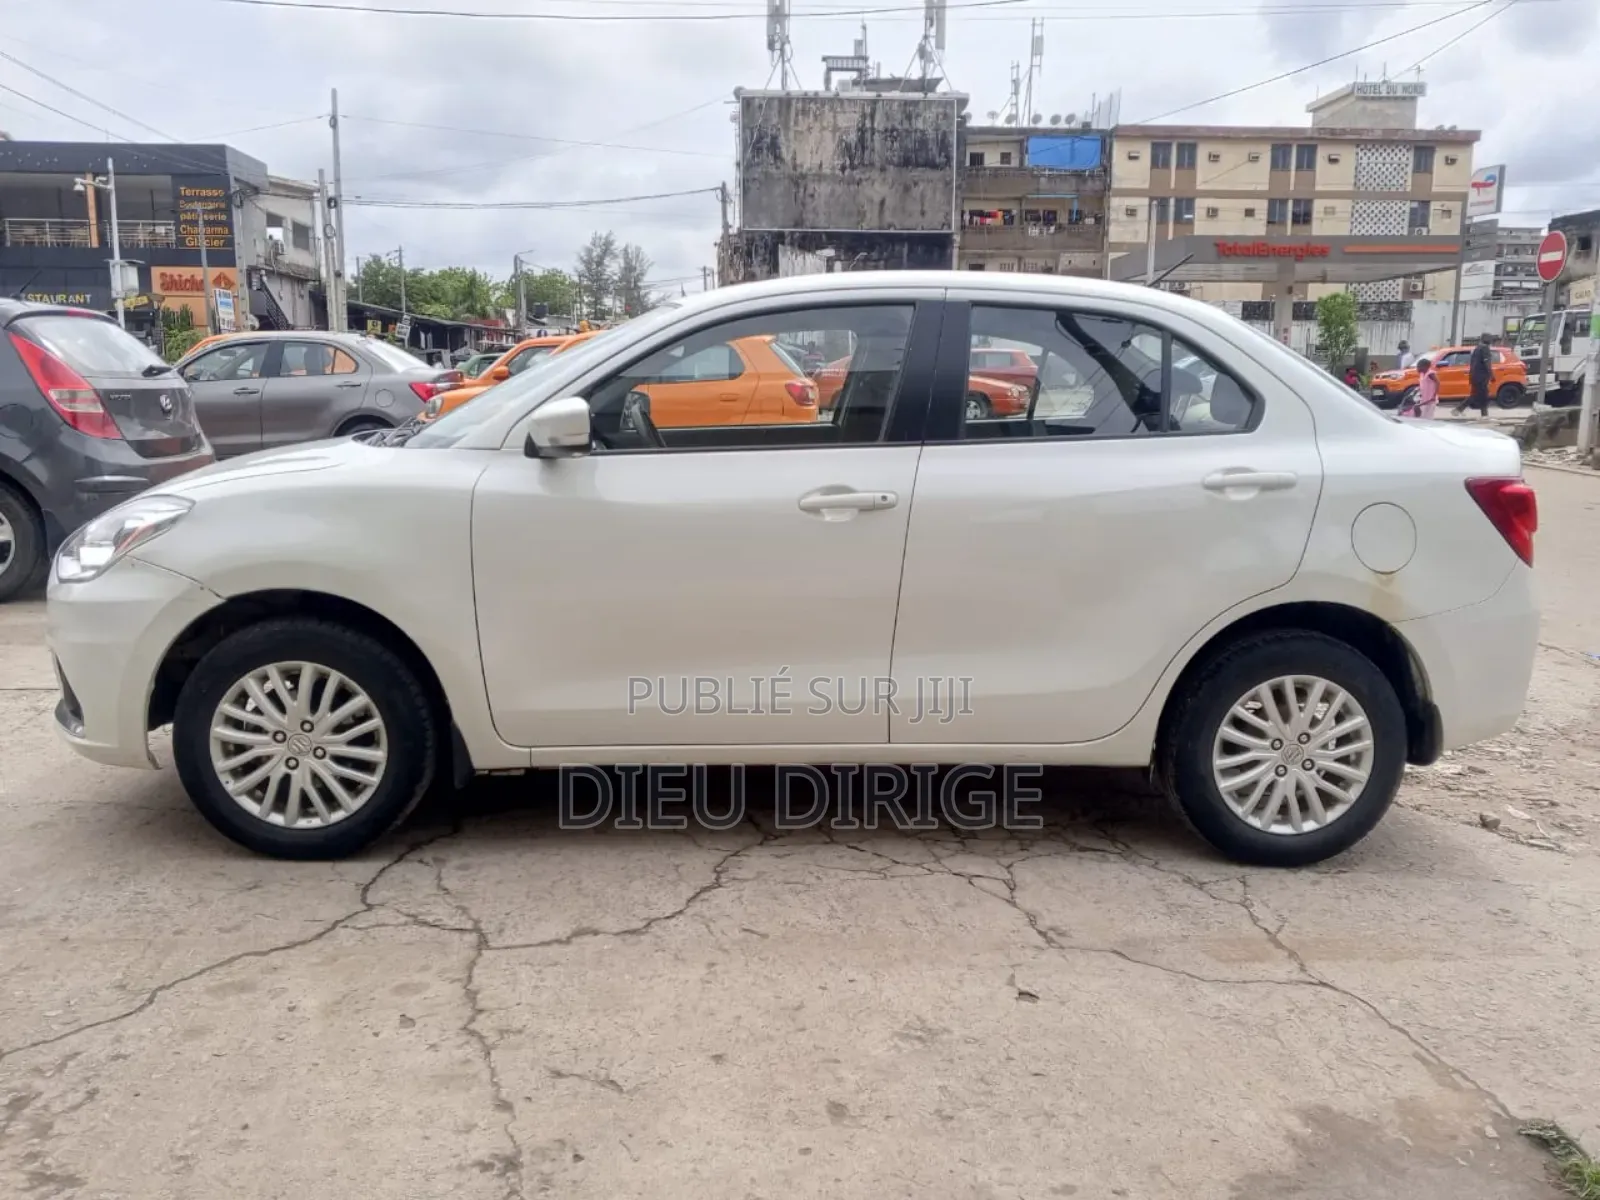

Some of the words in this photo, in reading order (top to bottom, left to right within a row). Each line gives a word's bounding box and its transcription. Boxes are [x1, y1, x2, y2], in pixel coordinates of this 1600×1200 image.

[180, 224, 229, 235] Chaarma
[185, 236, 226, 247] Glcier
[1214, 240, 1331, 262] TotalEnergies
[19, 292, 92, 305] STAURANT
